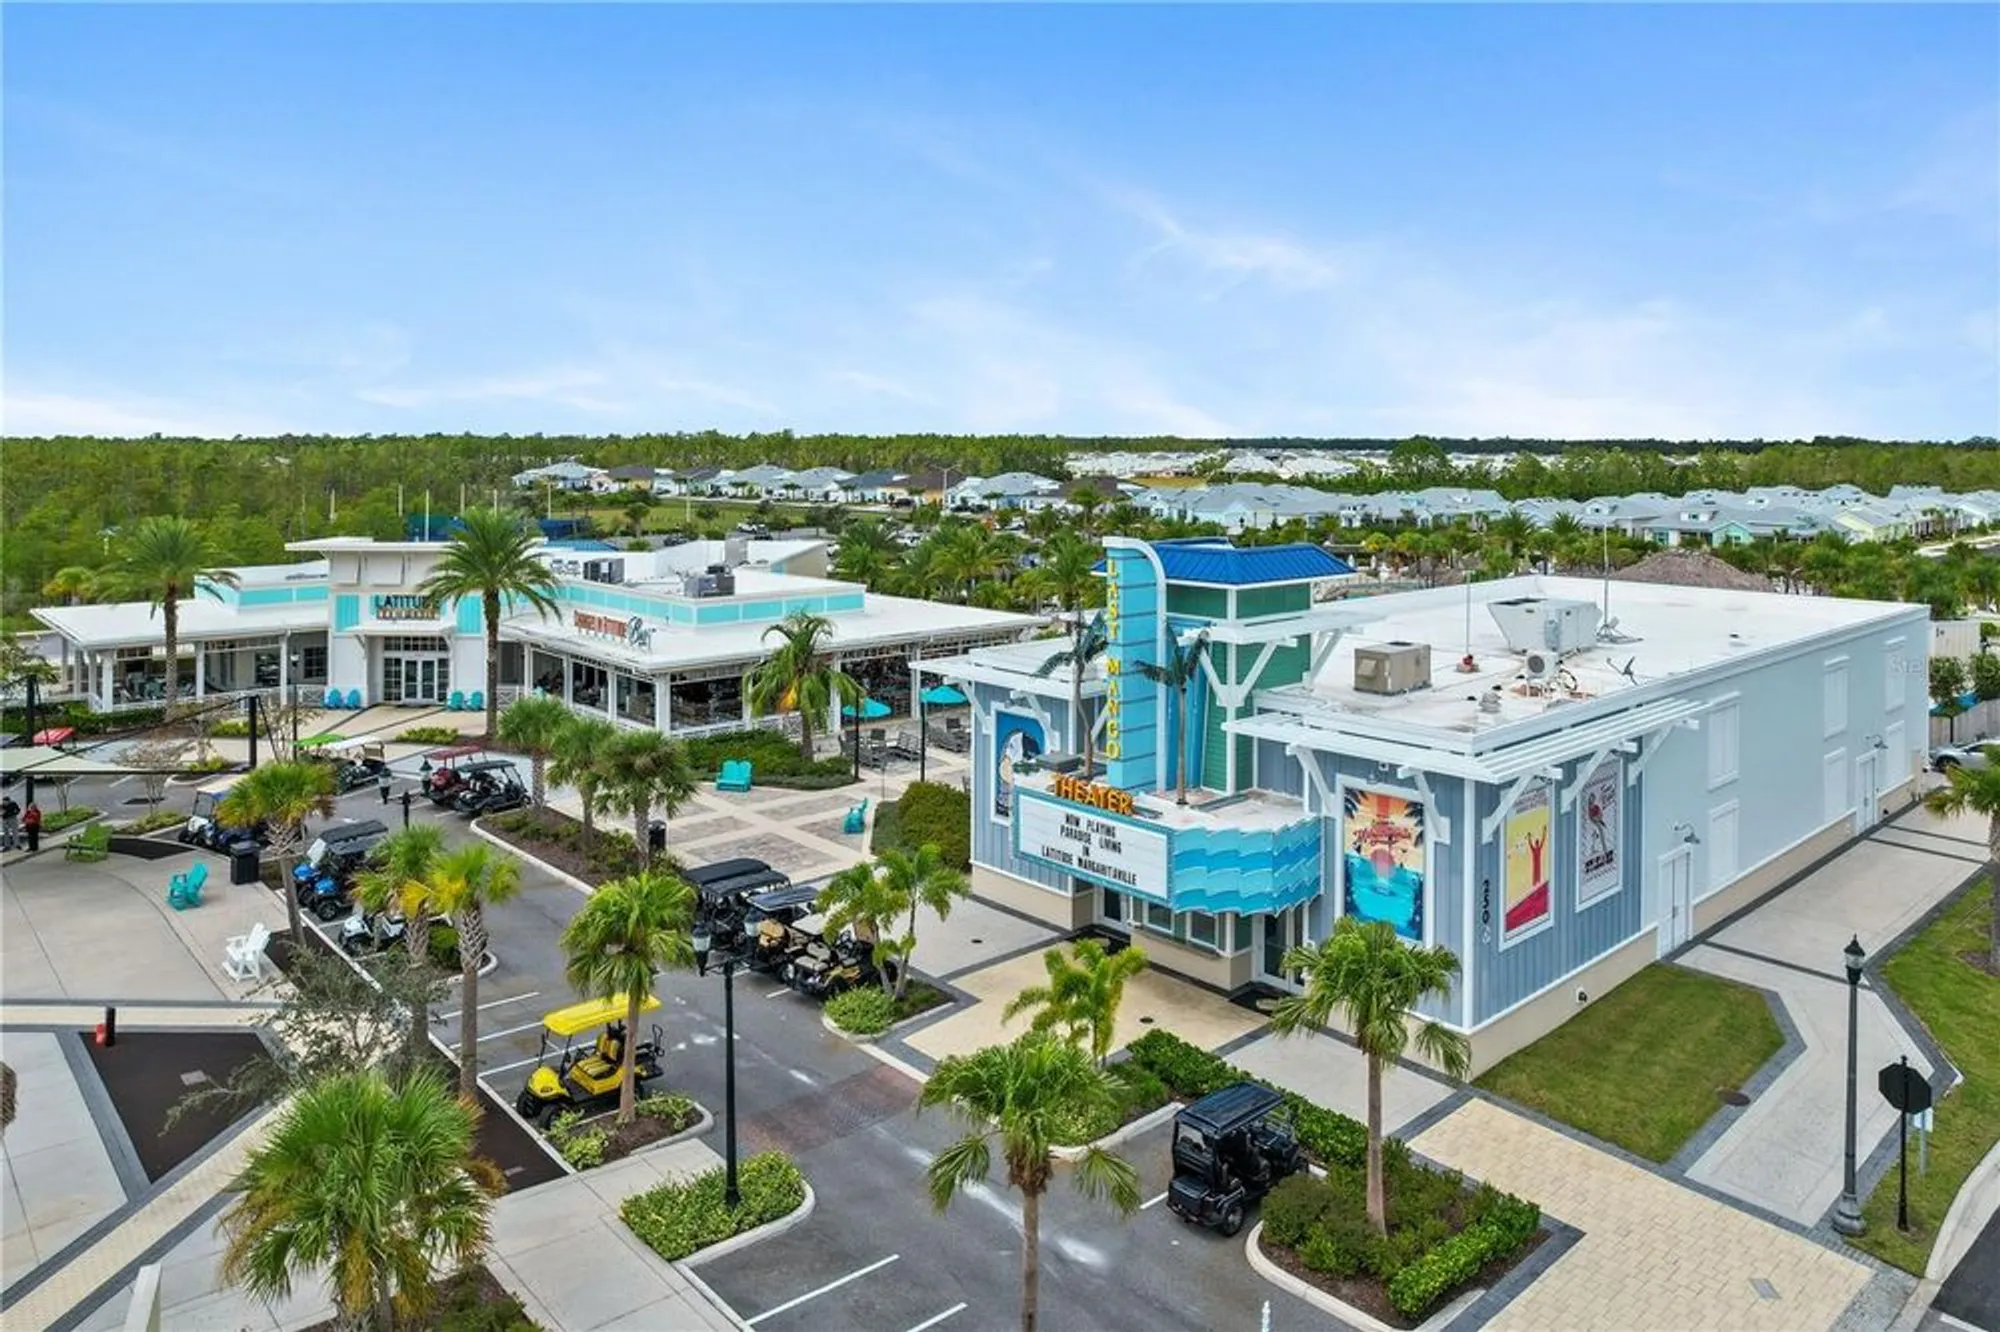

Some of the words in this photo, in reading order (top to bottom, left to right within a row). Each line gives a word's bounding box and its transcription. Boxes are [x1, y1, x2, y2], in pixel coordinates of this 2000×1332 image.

[374, 594, 441, 610] LATITU
[1106, 558, 1120, 640] LAST
[1106, 657, 1120, 760] MANGO
[1054, 774, 1133, 816] THEATER
[1060, 824, 1092, 845] PARADISE
[1099, 835, 1122, 855] LIVING
[1065, 813, 1081, 828] NOW
[1086, 819, 1116, 839] PLAYING
[1041, 845, 1074, 865] LATITUDE
[1077, 856, 1137, 885] MARGARITAVILLE
[1082, 845, 1090, 857] IN
